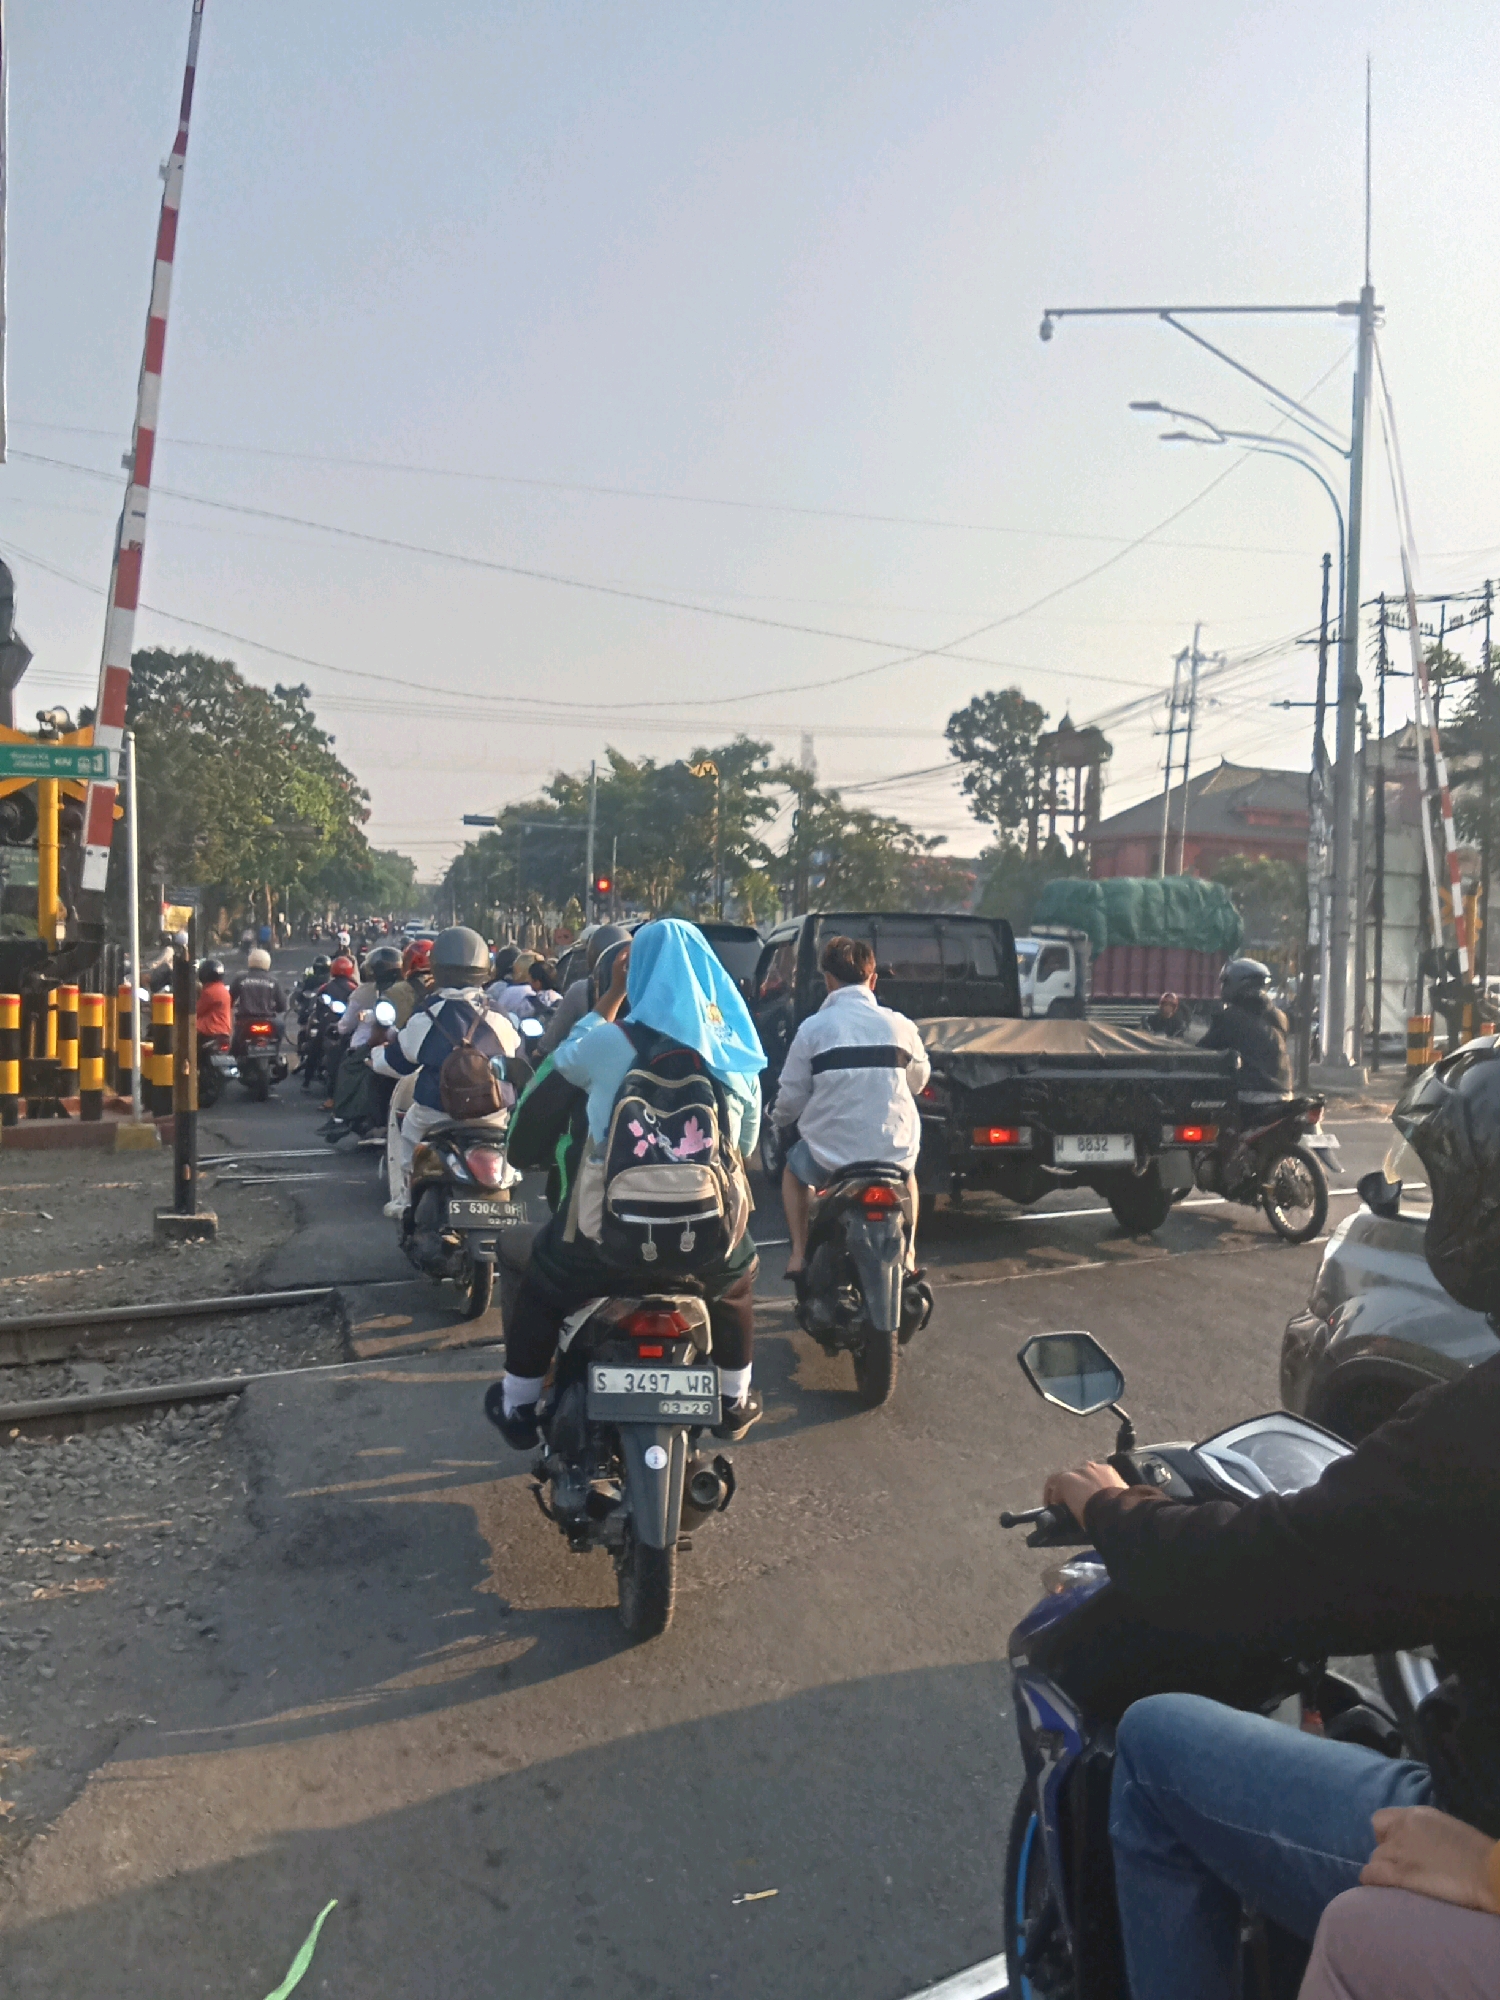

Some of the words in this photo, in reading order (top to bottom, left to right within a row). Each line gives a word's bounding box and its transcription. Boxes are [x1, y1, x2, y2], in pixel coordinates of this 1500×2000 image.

[1077, 1135, 1109, 1152] 8832
[452, 1202, 461, 1214] S
[596, 1372, 607, 1391] S
[624, 1373, 670, 1393] 3497
[687, 1375, 713, 1394] WR
